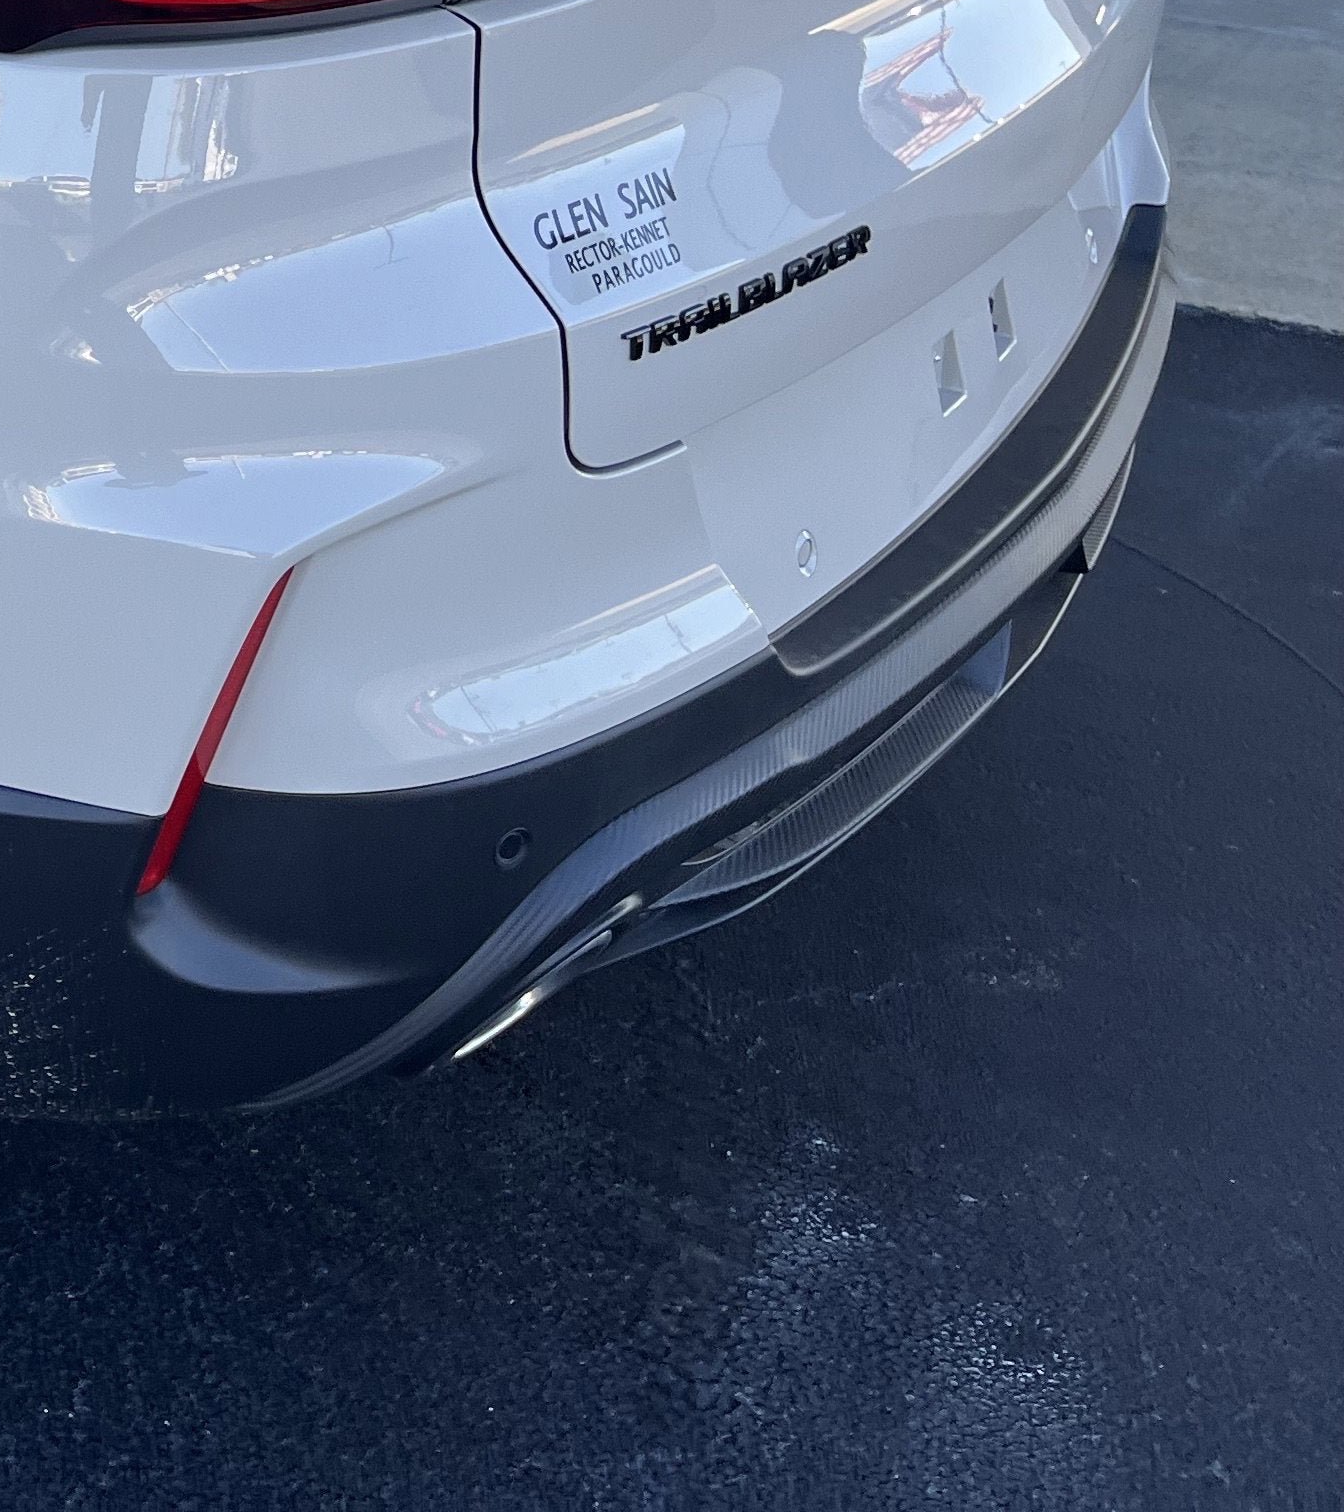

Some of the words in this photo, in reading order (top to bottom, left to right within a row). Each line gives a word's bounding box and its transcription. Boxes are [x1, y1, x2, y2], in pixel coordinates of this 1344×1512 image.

[533, 193, 609, 250] GLEN
[617, 167, 677, 219] SAIN
[564, 217, 671, 274] RECTOR-KENNET
[591, 243, 681, 295] PARAGOULD
[620, 224, 872, 361] TRAILBLAZER
